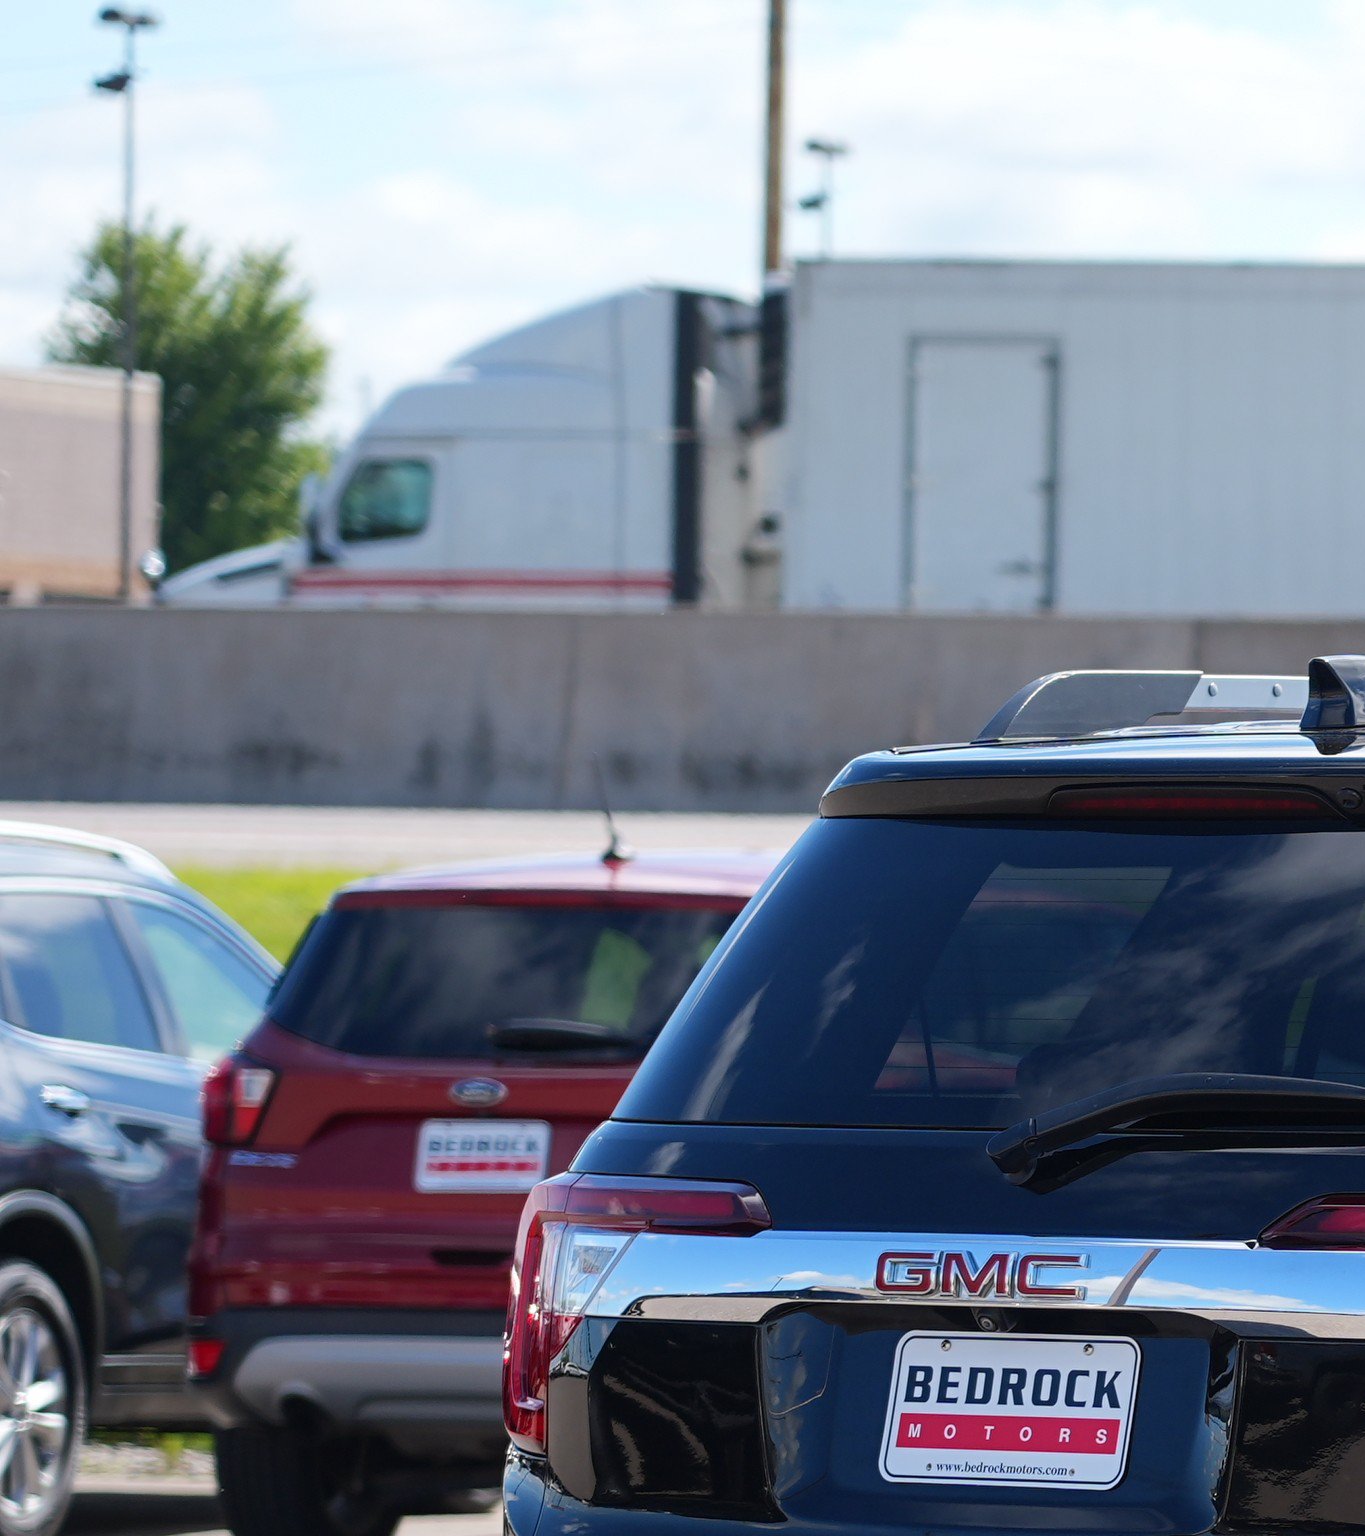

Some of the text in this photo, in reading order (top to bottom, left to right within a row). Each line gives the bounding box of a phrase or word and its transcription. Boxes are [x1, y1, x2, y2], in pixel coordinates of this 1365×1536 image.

[873, 1250, 1091, 1300] GMC
[904, 1365, 1122, 1409] BEDROCK
[908, 1423, 1108, 1445] MOTORS
[936, 1461, 1068, 1476] www.bedrockmotors.com
